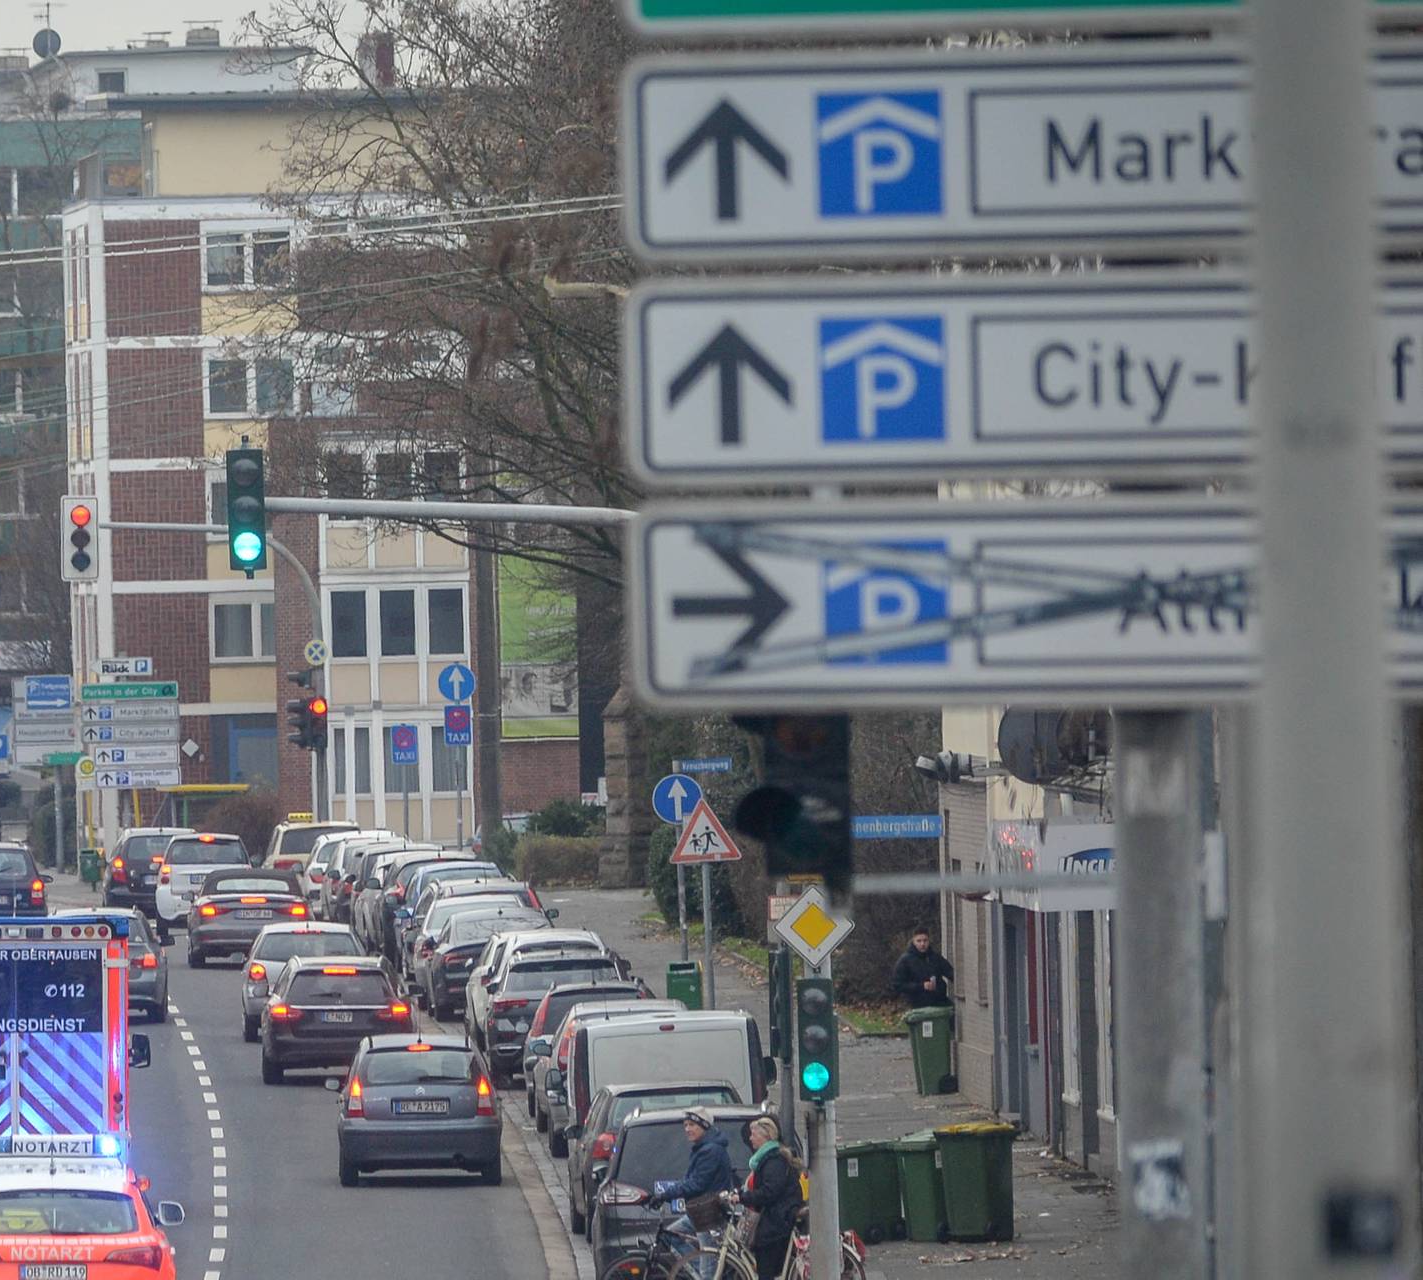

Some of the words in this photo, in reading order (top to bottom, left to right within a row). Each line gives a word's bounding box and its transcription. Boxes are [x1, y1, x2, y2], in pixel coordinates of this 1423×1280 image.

[84, 688, 112, 697] Parken
[114, 687, 122, 696] in
[125, 687, 139, 696] der
[141, 687, 158, 697] City
[119, 728, 170, 738] City-Kaufhof
[447, 733, 469, 742] TAXI
[395, 752, 415, 760] TAXI
[11, 950, 97, 961] OBERHAUSEN
[59, 984, 85, 998] 112
[13, 1141, 91, 1154] NOTARZT
[10, 1246, 95, 1261] NOTARZT
[48, 1266, 63, 1278] RD
[65, 1266, 86, 1279] 119
